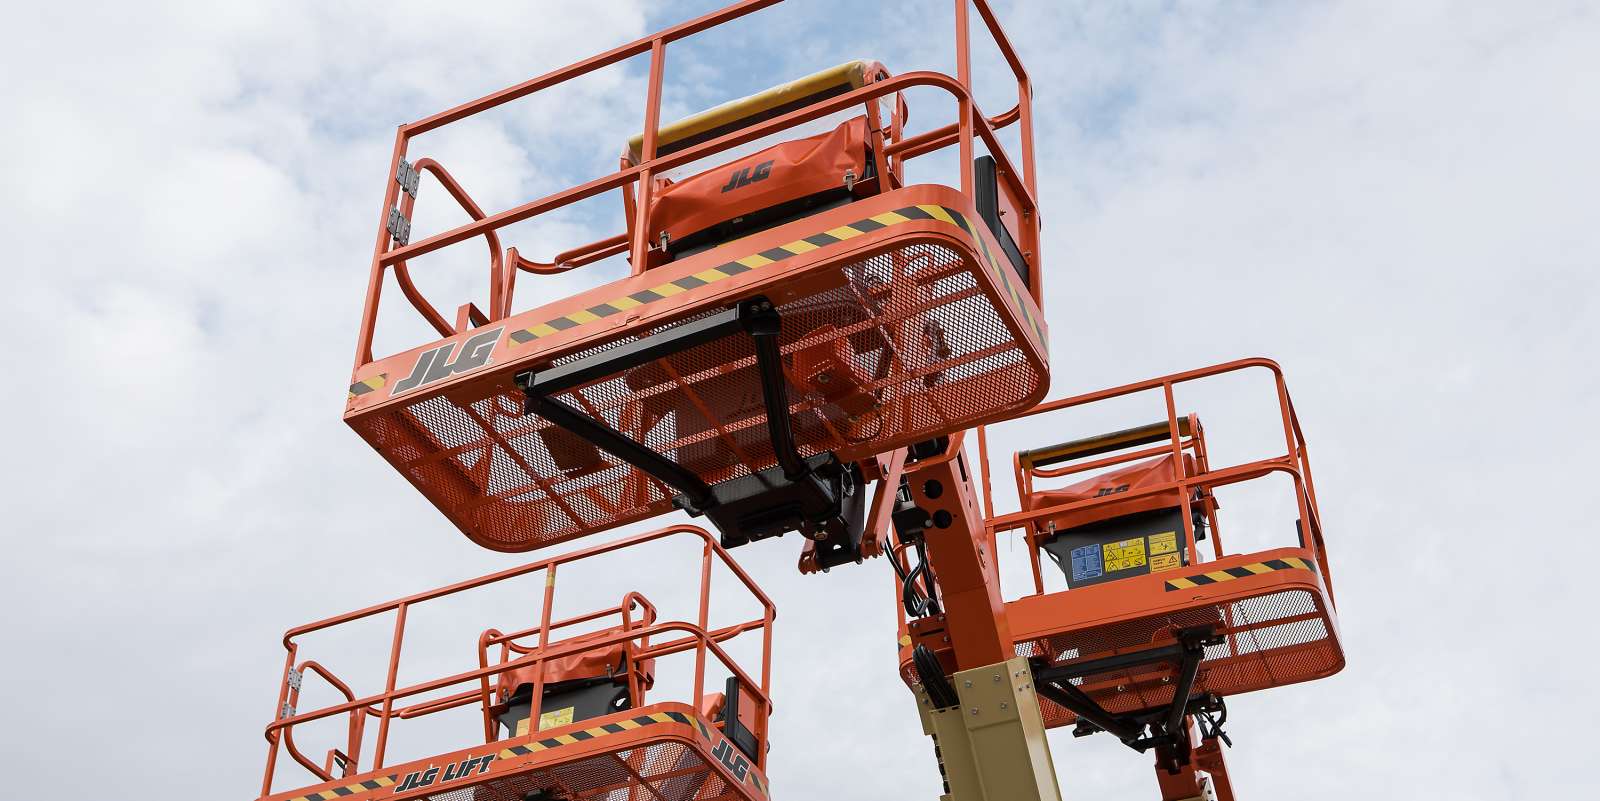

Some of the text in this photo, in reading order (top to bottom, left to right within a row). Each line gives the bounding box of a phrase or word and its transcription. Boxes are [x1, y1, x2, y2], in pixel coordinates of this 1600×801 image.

[721, 160, 774, 193] JLG
[389, 327, 504, 397] JLG
[393, 753, 497, 794] JLG LIFT
[711, 738, 750, 784] JLG
